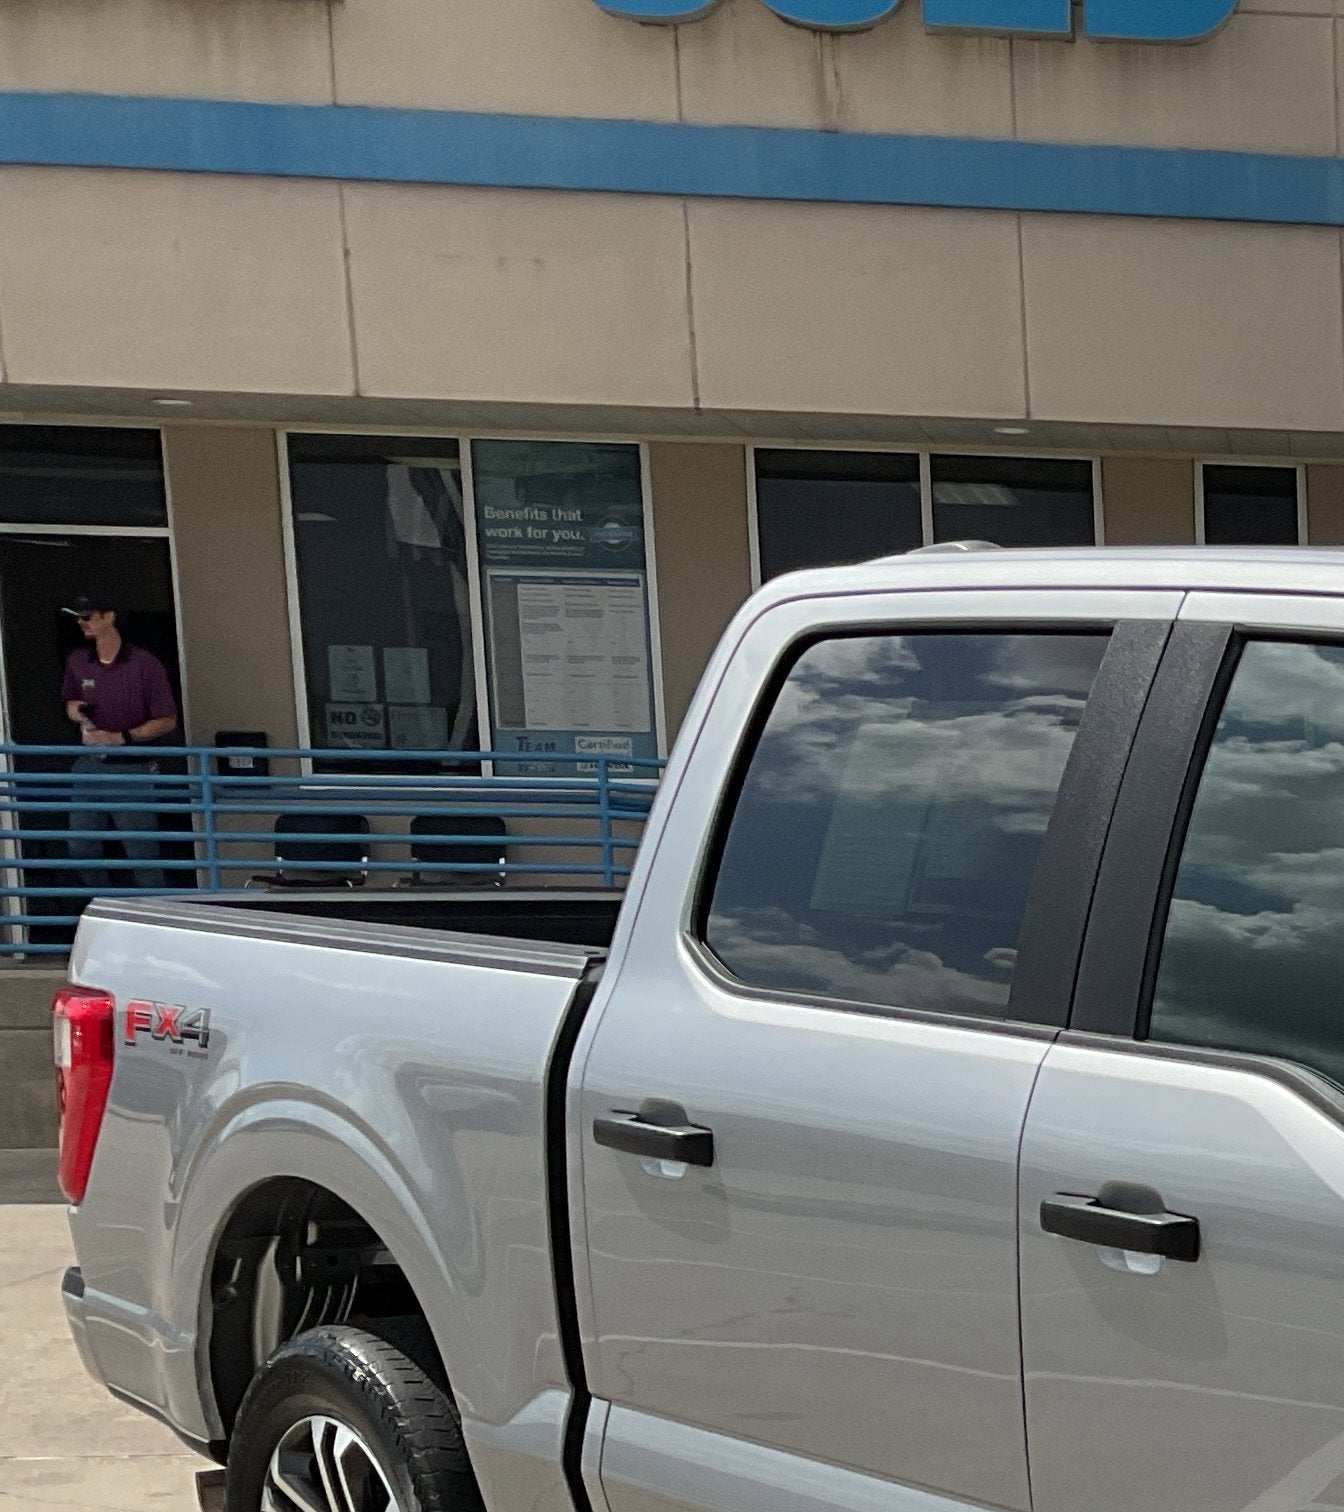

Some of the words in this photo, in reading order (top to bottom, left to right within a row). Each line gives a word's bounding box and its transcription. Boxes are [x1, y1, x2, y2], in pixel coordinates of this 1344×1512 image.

[484, 505, 548, 521] Benefits
[552, 508, 583, 521] that
[485, 526, 523, 539] work
[526, 526, 547, 539] for
[553, 529, 585, 543] you.
[124, 997, 211, 1049] FX4
